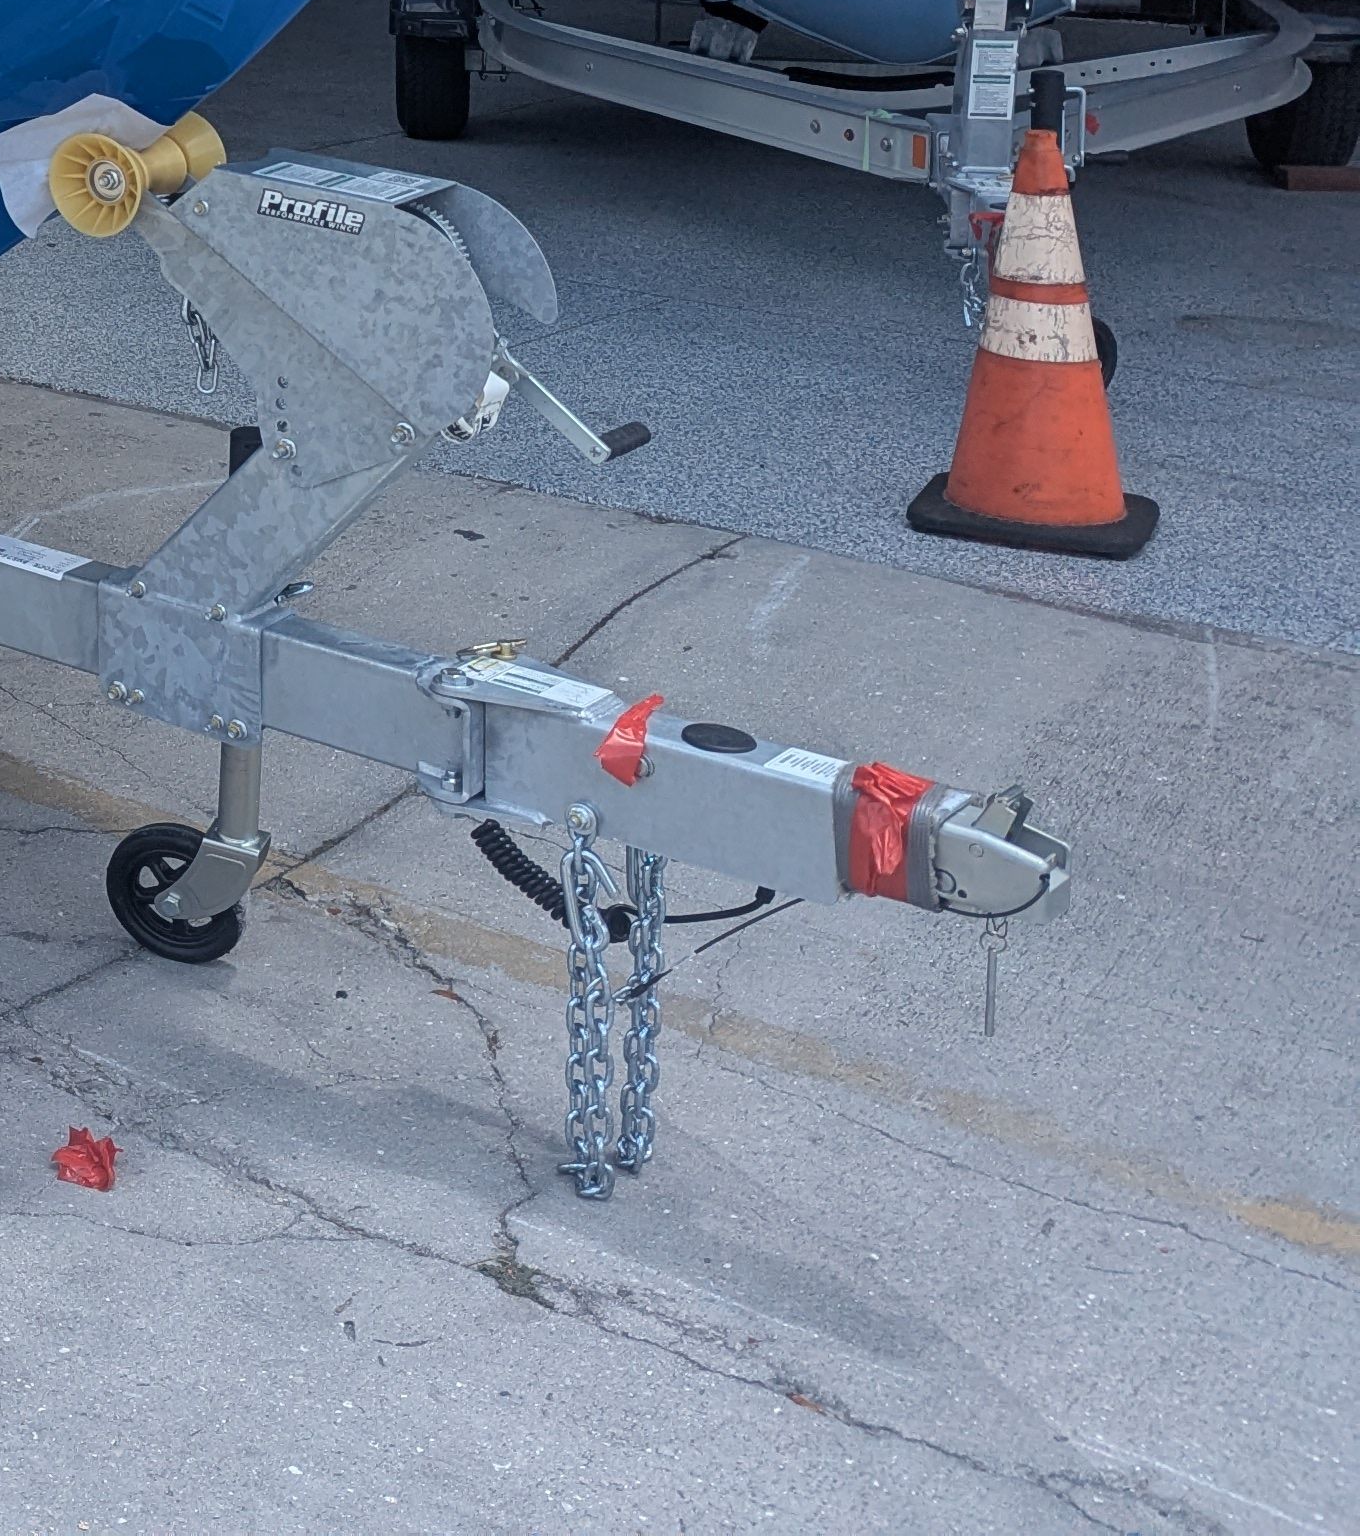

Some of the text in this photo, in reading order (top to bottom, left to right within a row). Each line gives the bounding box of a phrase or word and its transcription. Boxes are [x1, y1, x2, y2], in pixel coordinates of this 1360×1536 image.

[259, 207, 359, 233] PERFORMANCE WINCH
[260, 189, 365, 228] Profile
